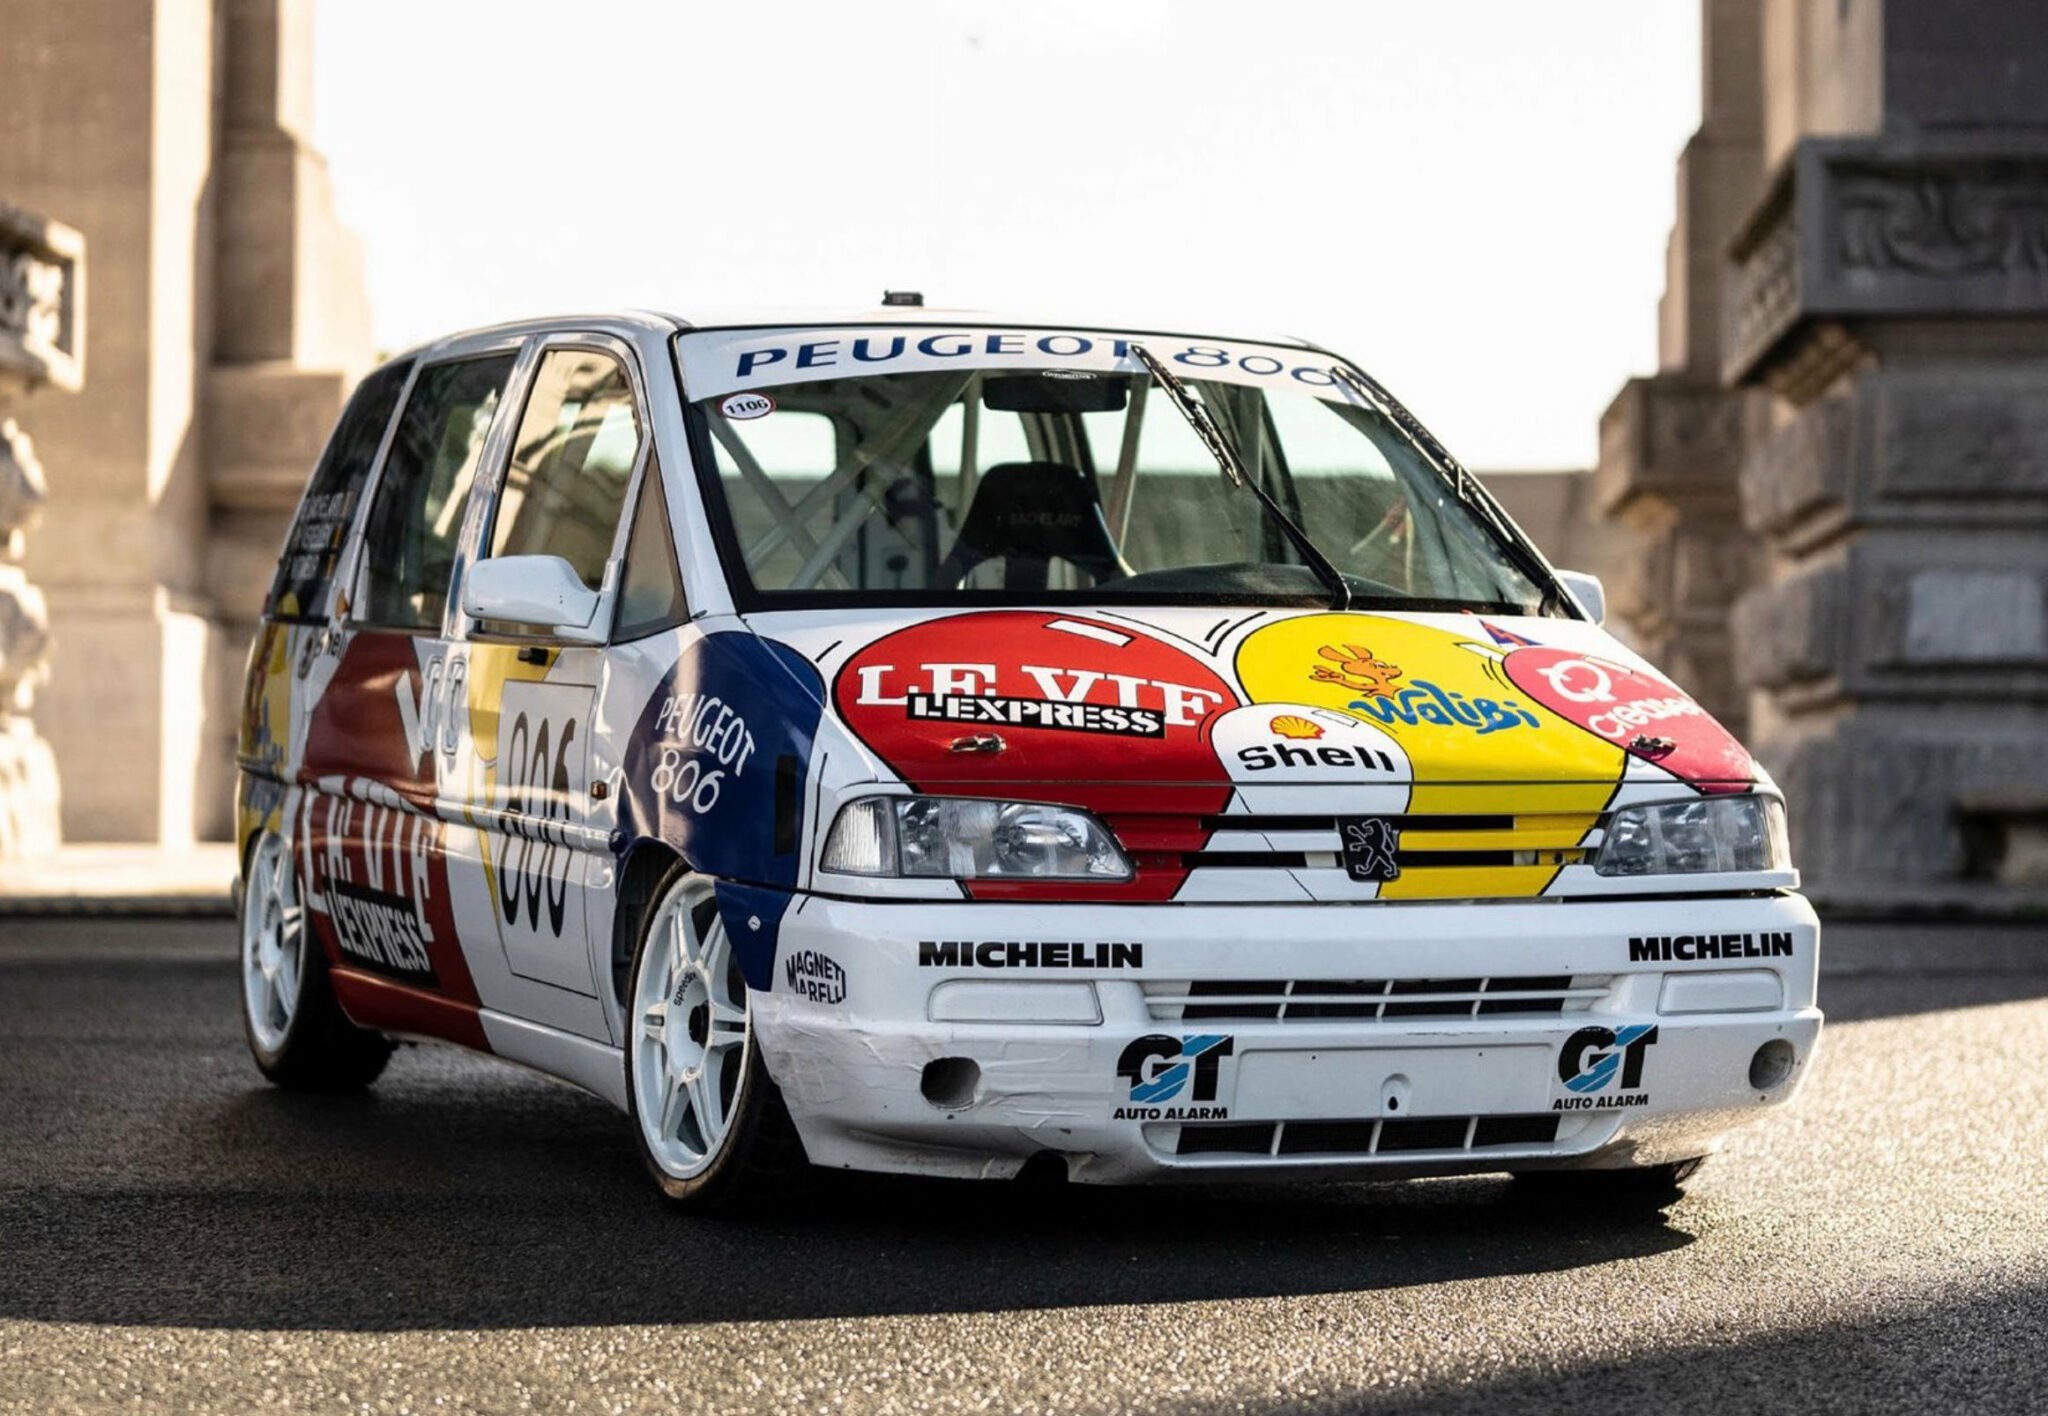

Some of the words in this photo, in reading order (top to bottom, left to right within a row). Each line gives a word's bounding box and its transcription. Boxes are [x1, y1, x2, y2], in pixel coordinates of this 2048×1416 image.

[736, 335, 1144, 377] PEUGEOT
[726, 399, 769, 414] 1106
[856, 662, 997, 707] LE
[1021, 665, 1222, 727] VIF
[654, 693, 756, 777] PEUGEOT
[1238, 743, 1396, 772] Shell
[651, 748, 725, 814] 806
[500, 711, 576, 938] 806
[919, 941, 1143, 969] MICHELIN
[1628, 932, 1794, 962] MICHELIN
[1117, 1033, 1234, 1104] GT
[1558, 1024, 1659, 1093] GT
[1113, 1107, 1161, 1120] AUTO
[1165, 1107, 1228, 1120] ALARM
[1552, 1098, 1593, 1110] AUTO
[1596, 1094, 1649, 1108] ALARM
